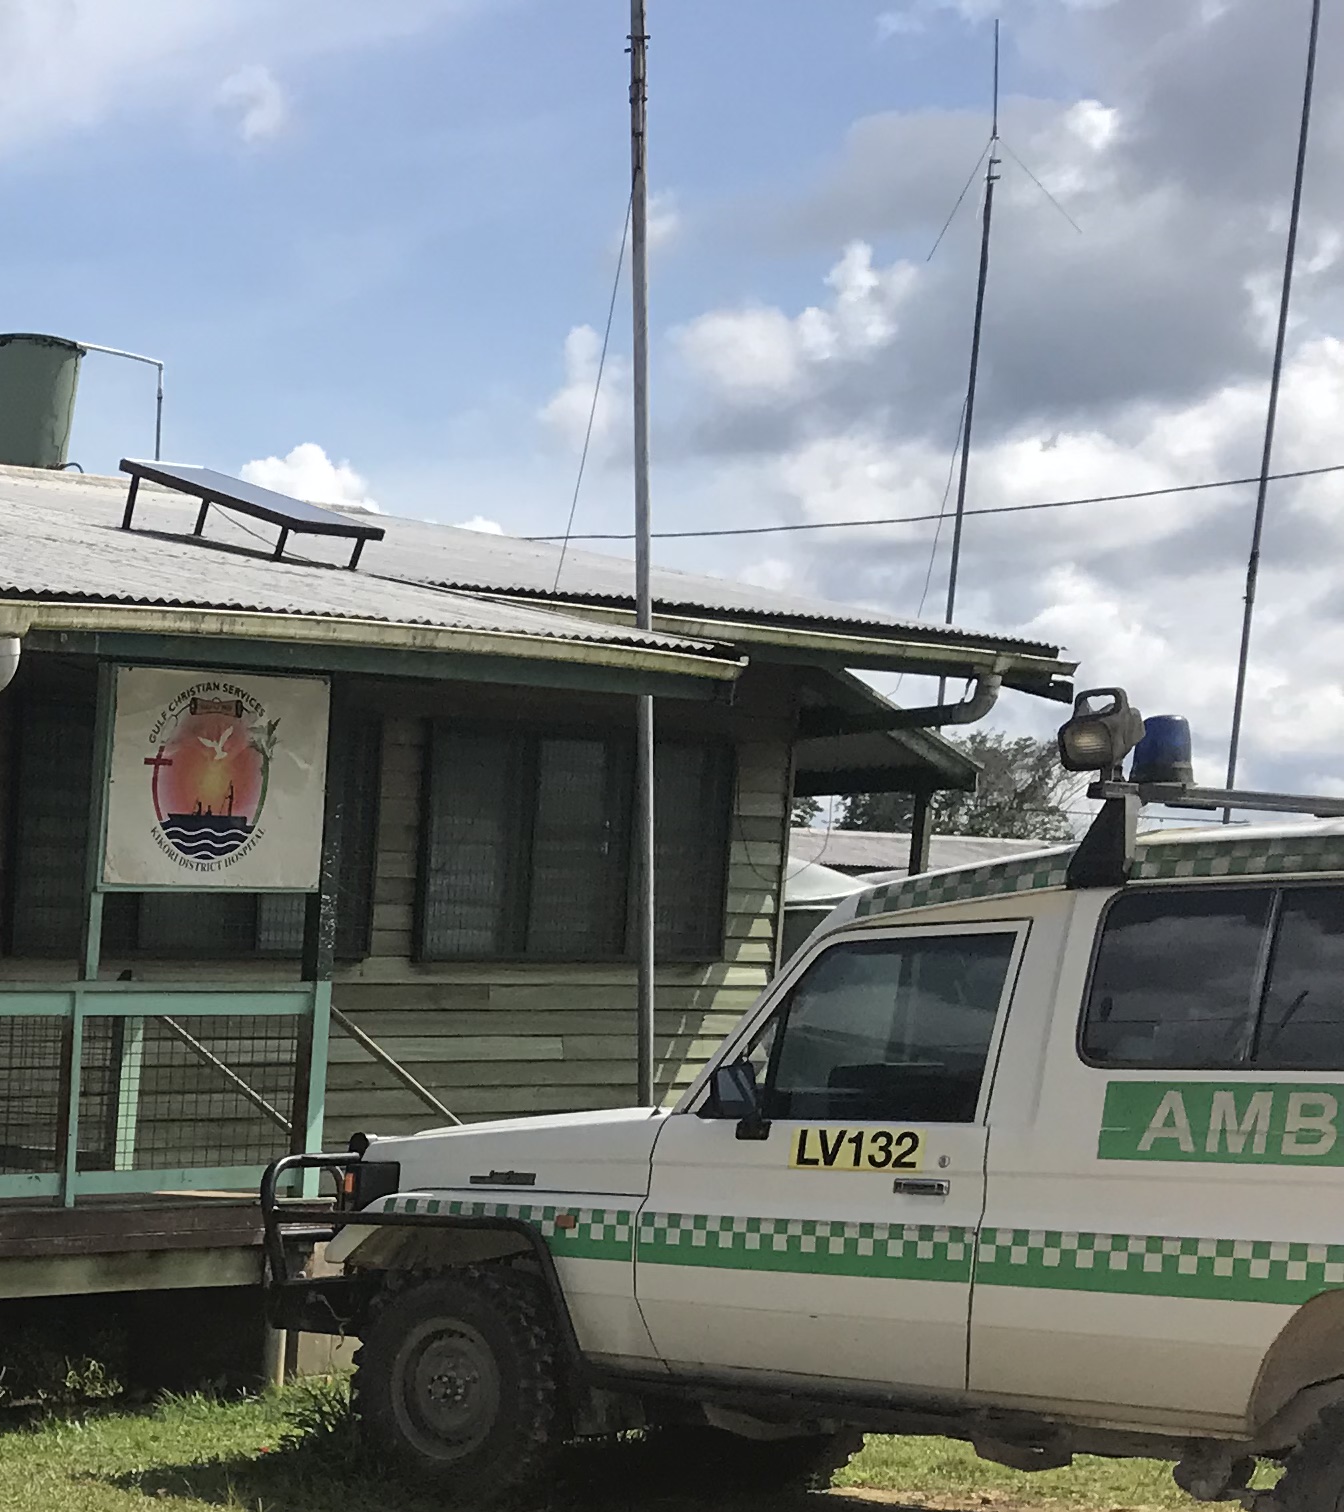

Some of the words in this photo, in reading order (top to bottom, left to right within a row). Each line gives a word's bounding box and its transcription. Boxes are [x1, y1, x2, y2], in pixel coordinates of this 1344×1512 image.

[148, 711, 168, 744] GULF
[168, 681, 221, 712] CHRISTIAN
[222, 683, 266, 718] SERVICES
[150, 825, 178, 864] KIKORI
[178, 856, 223, 872] DISTRICT
[224, 828, 267, 868] HOSPITAL
[795, 1129, 921, 1170] LV132
[1137, 1089, 1338, 1157] AMB
